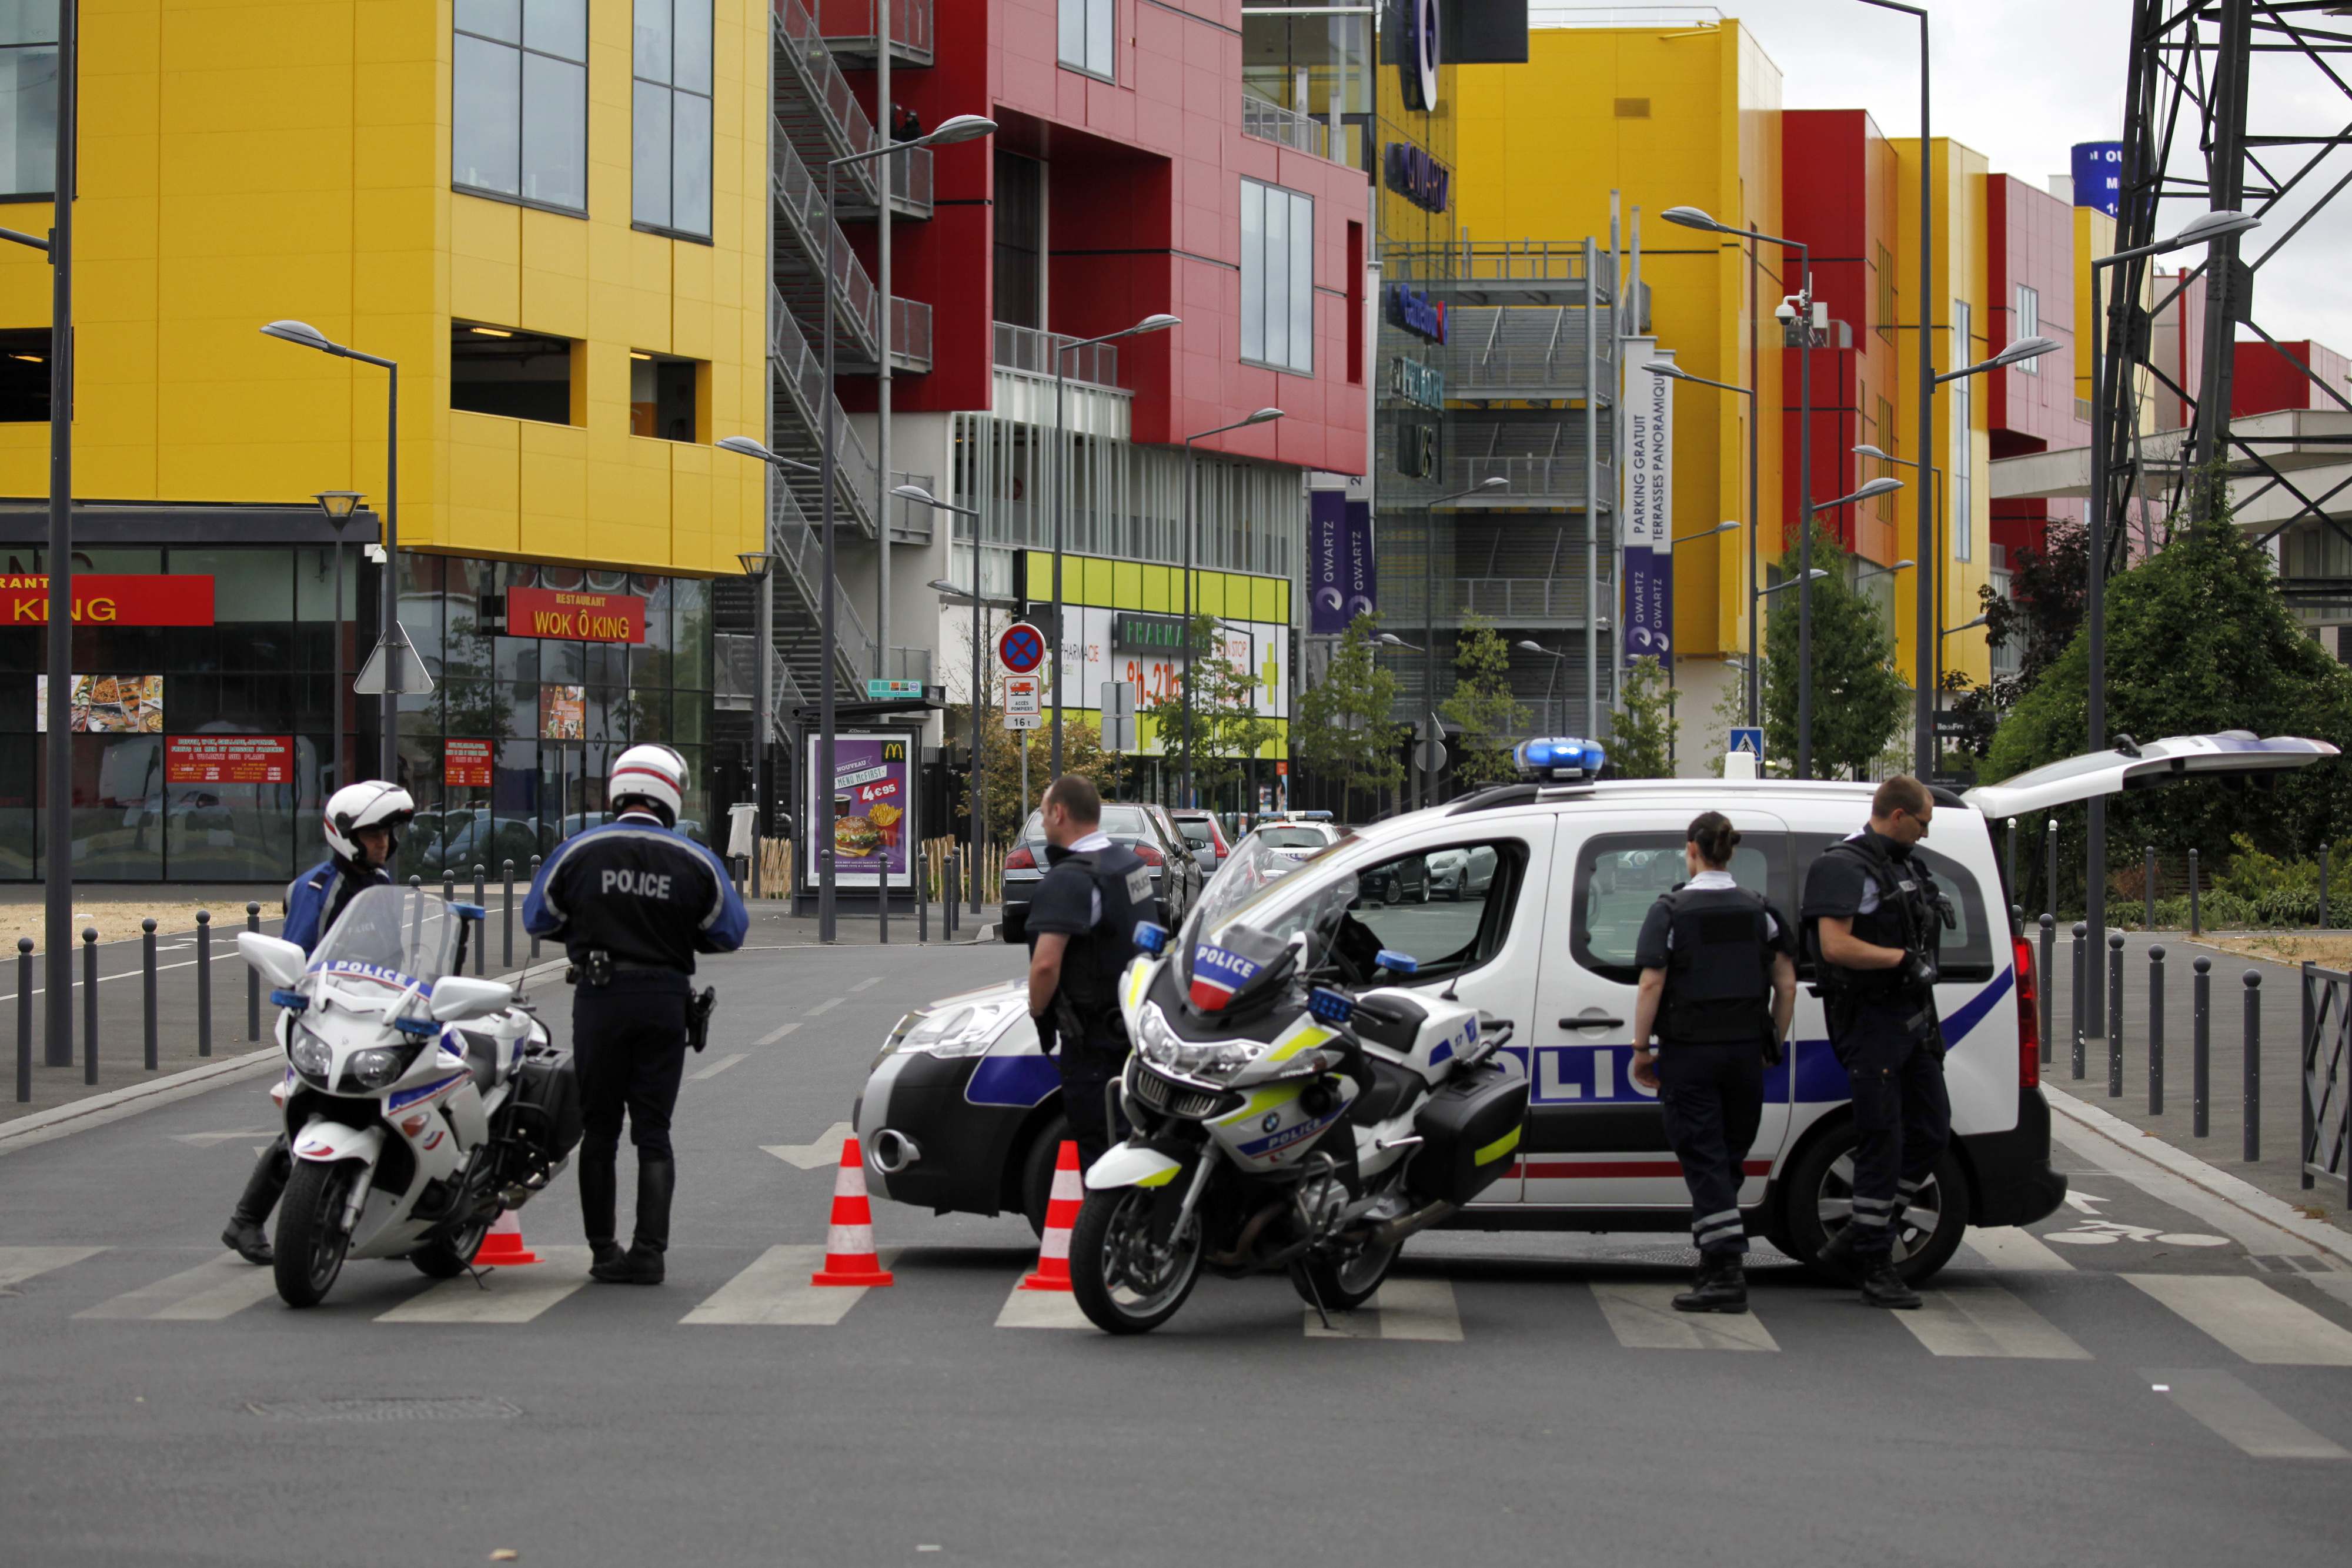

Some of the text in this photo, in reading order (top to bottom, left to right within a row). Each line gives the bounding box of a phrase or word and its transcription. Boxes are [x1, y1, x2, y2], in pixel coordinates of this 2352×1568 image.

[1634, 415, 1645, 533] PARKING GRATUIT
[1653, 475, 1663, 540] TERRASSES
[1324, 521, 1334, 582] QWARTZ
[1352, 531, 1363, 590] QWARTZ
[556, 594, 606, 607] RESTAURANT
[1635, 571, 1644, 623] QWARTZ
[1653, 579, 1662, 628] QWARTZ
[535, 609, 630, 638] WOK Ô KING
[1232, 641, 1247, 657] STOP
[1014, 718, 1025, 727] 16
[836, 760, 867, 772] NOUVEAU
[837, 768, 881, 787] MENU McFIRST
[862, 784, 896, 801] 4€95
[602, 869, 671, 899] POLICE
[335, 960, 408, 985] POLICE
[1196, 946, 1255, 978] POLICE
[1269, 1118, 1321, 1146] POLICE
